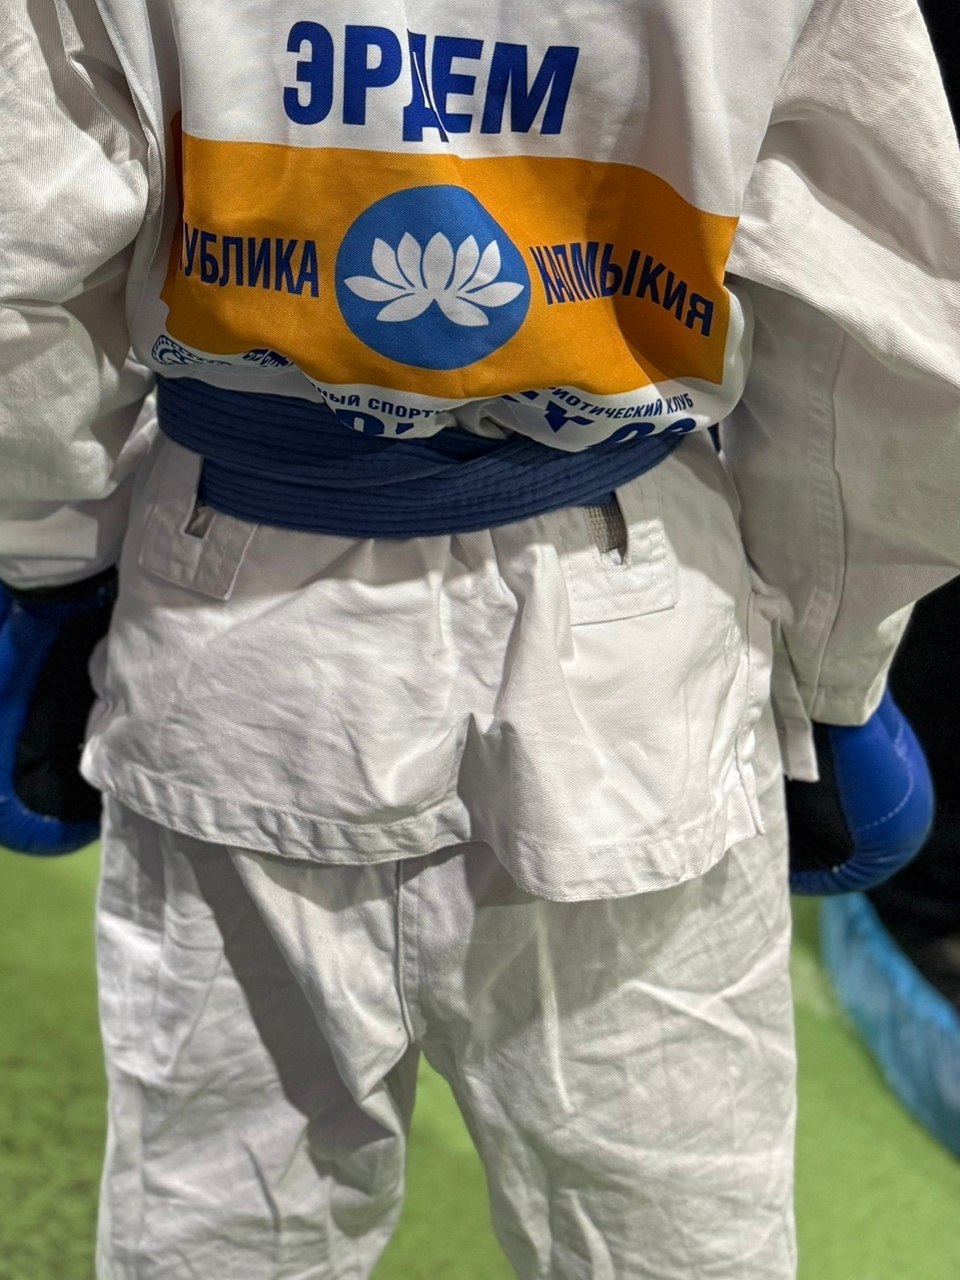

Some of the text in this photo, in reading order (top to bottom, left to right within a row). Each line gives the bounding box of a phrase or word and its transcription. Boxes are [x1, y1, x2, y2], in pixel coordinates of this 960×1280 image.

[282, 20, 579, 142] ЭРДЕМ
[179, 222, 714, 336] УБЛИКА КАЛМЫКИЯ
[368, 397, 441, 419] СПОРТ
[546, 387, 663, 419] ИОТИЧЕСКИЙ
